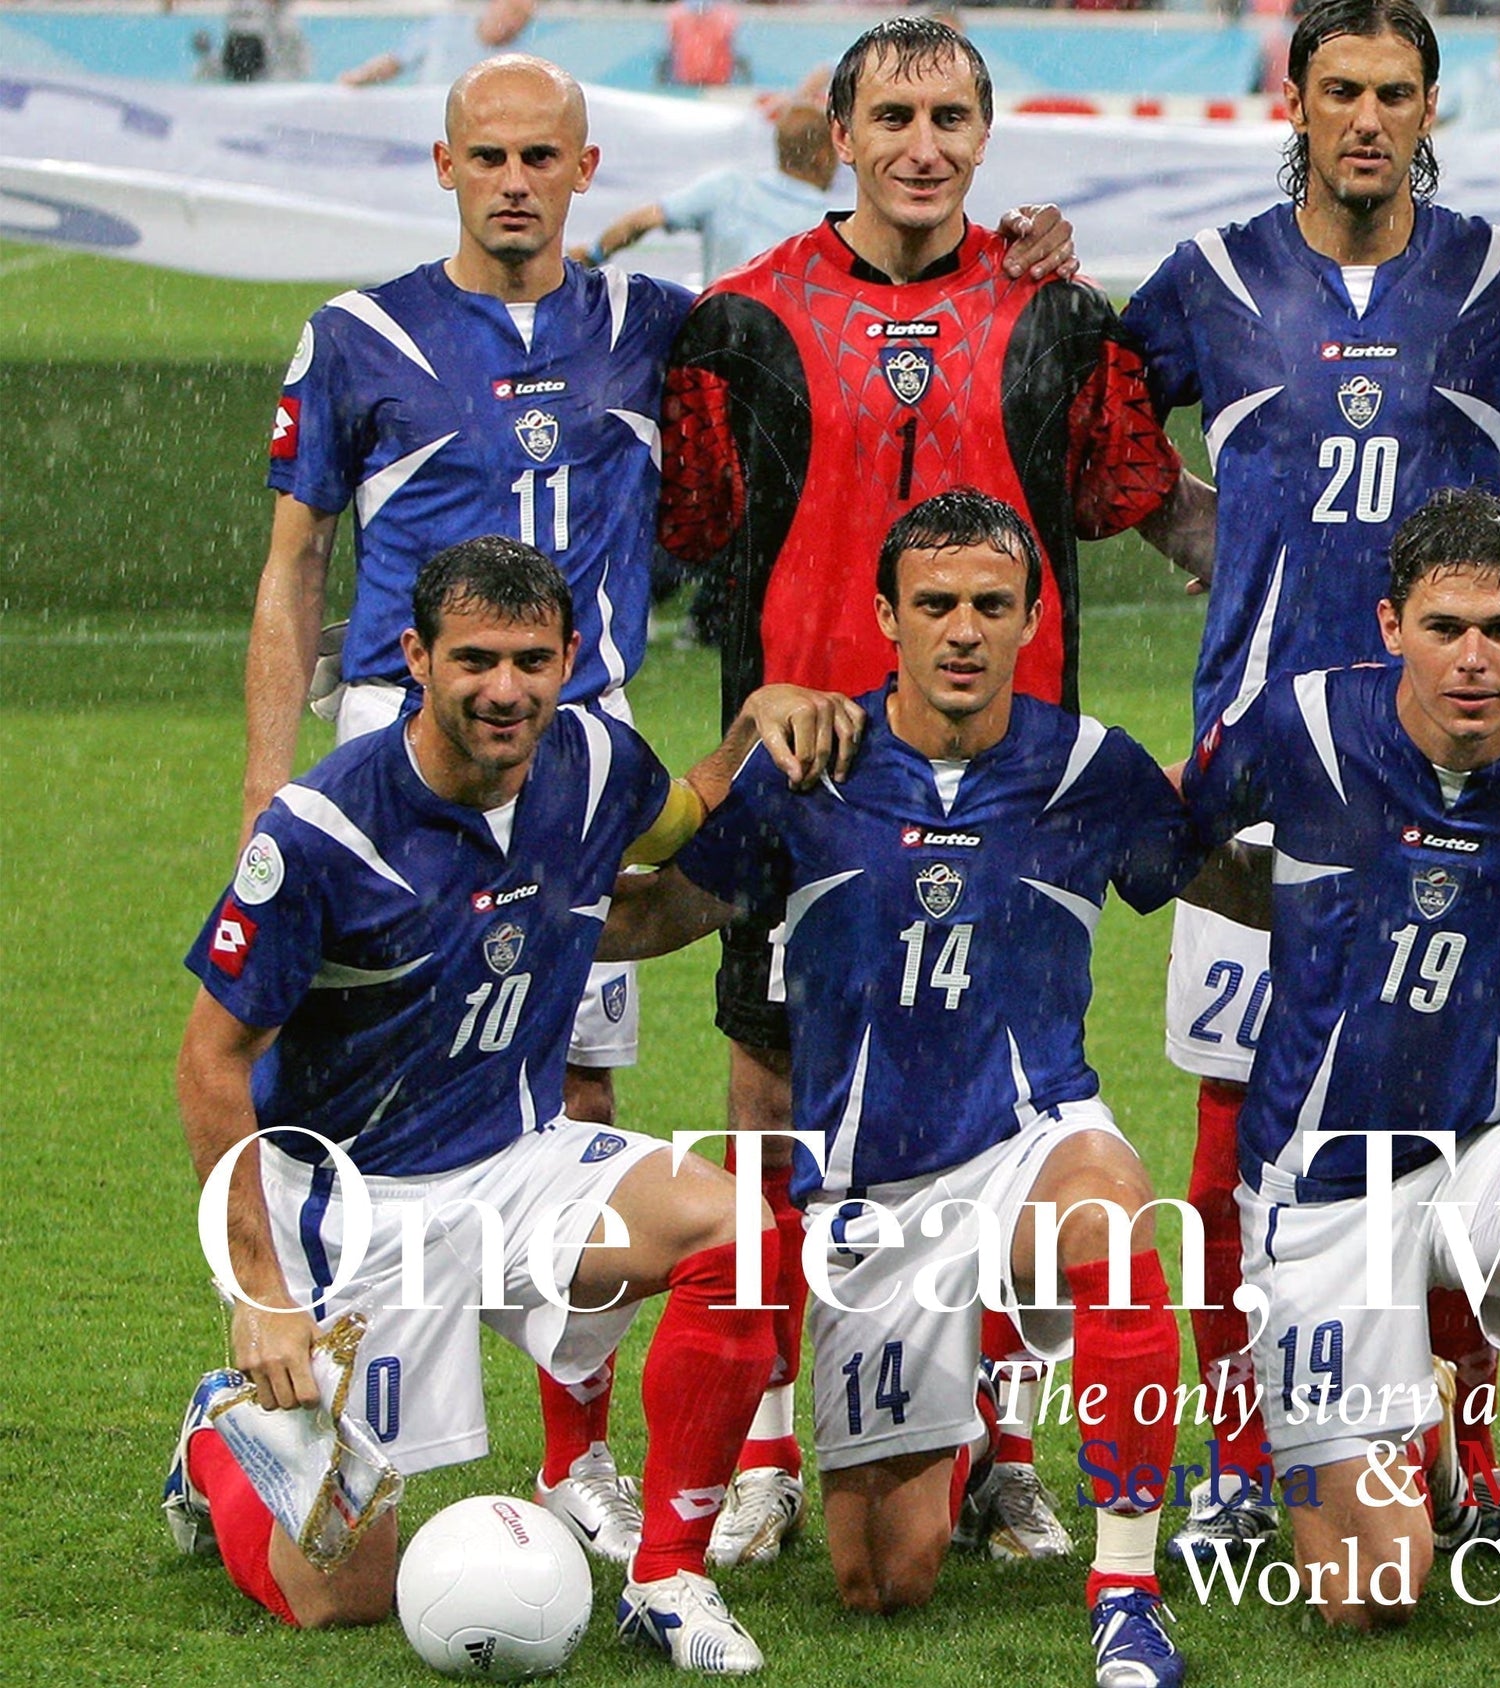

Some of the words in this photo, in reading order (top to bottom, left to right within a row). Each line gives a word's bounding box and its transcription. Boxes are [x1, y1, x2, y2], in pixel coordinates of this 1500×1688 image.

[895, 416, 918, 501] 1
[1311, 435, 1400, 524] 20
[511, 464, 570, 552] 11
[899, 920, 974, 1010] 14
[1379, 923, 1468, 1014] 19
[448, 972, 532, 1059] 10
[841, 1340, 911, 1435] 14
